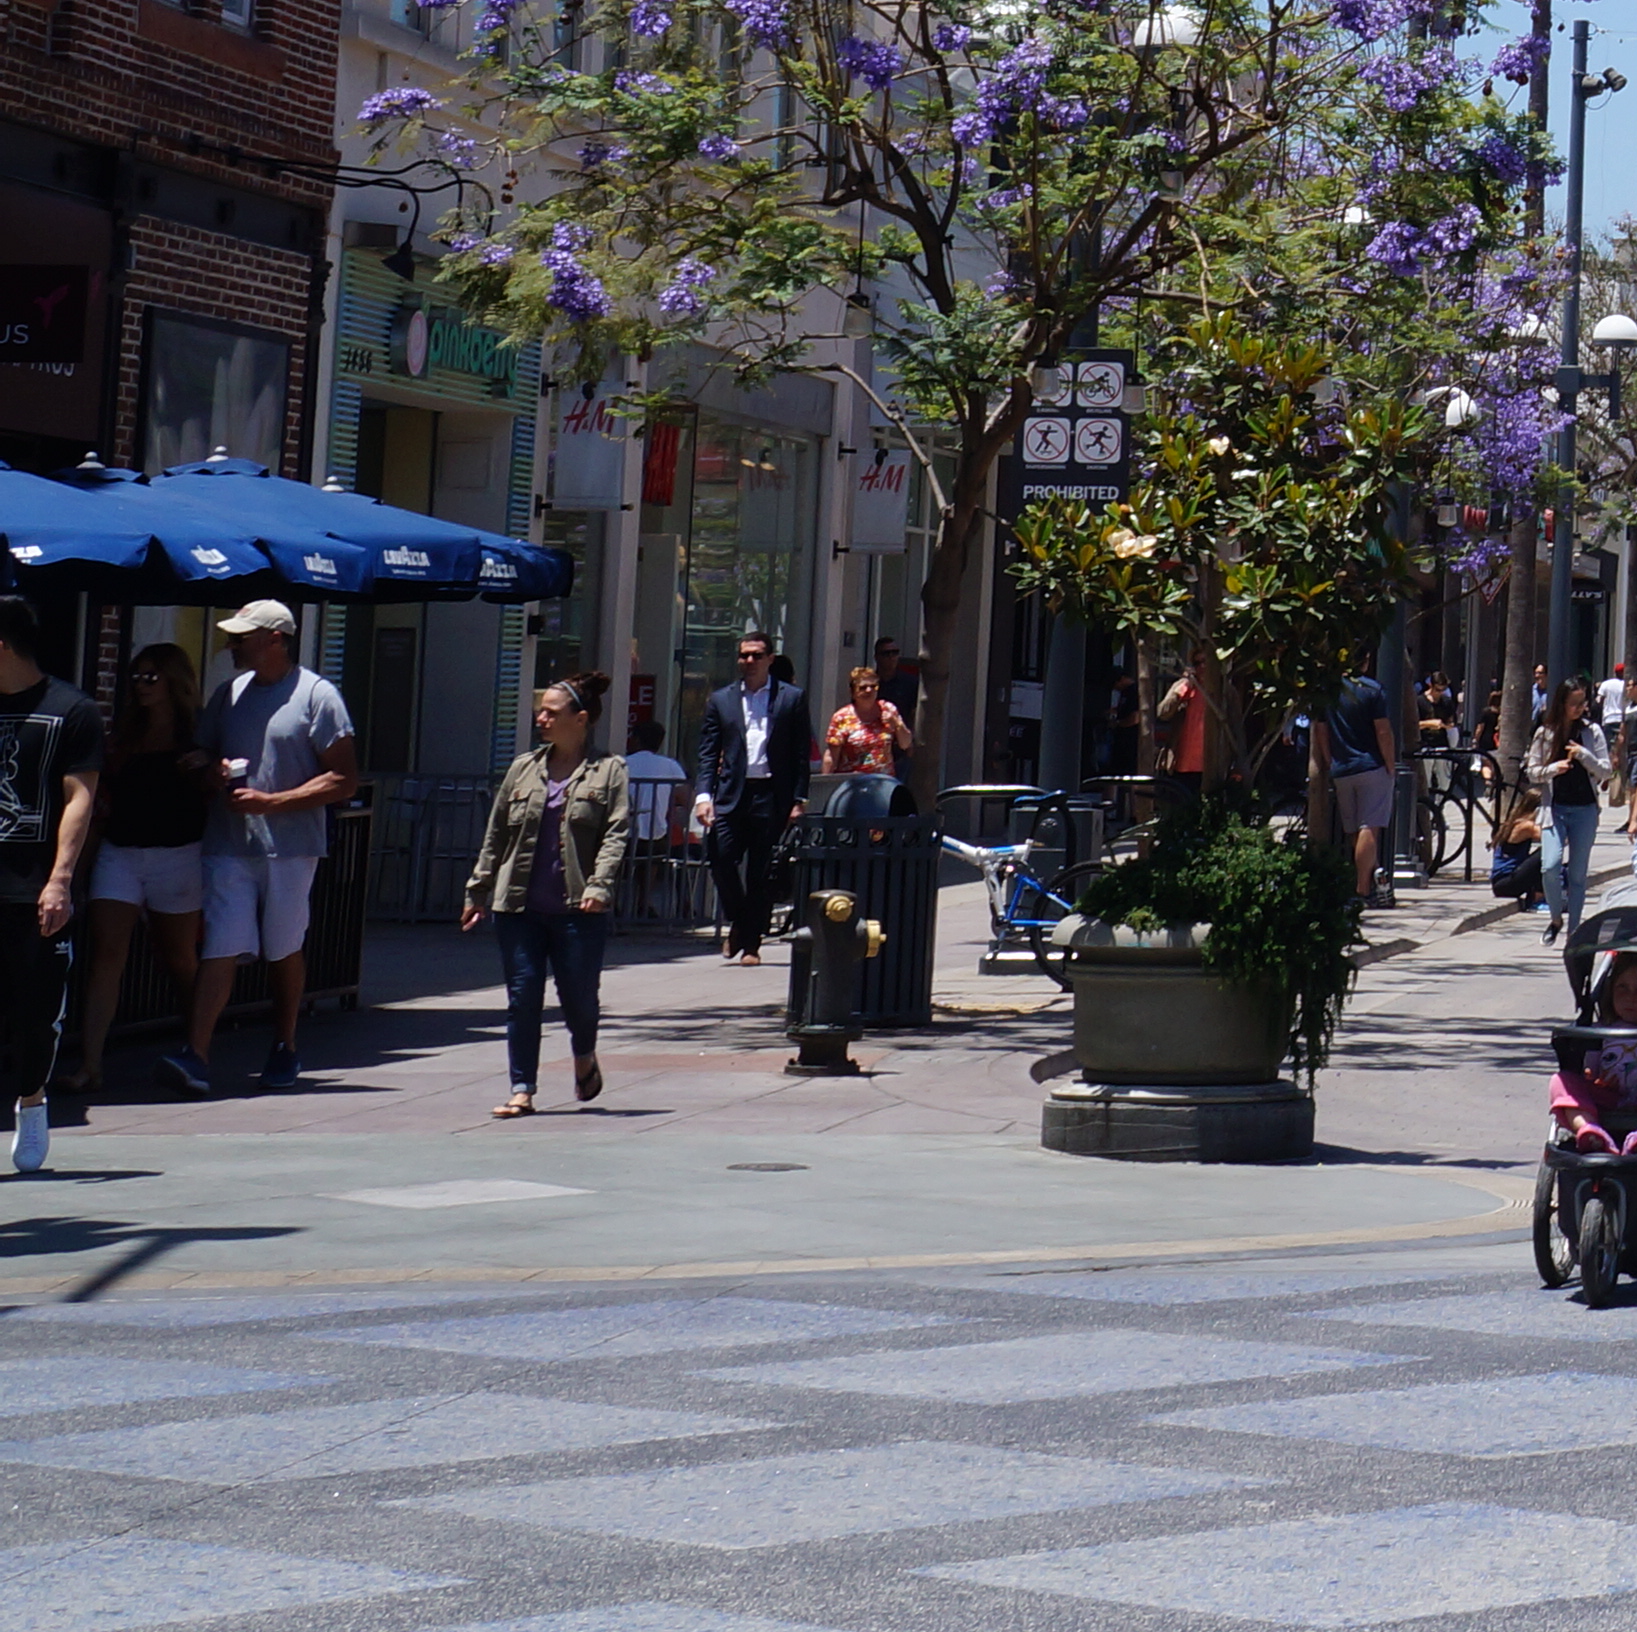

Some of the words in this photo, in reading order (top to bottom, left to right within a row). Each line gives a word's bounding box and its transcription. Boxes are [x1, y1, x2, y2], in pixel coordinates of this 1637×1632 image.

[563, 399, 620, 435] H&M
[859, 464, 906, 494] H&M
[1022, 484, 1120, 501] PROHIBITED
[383, 545, 431, 568] LAVAZZA
